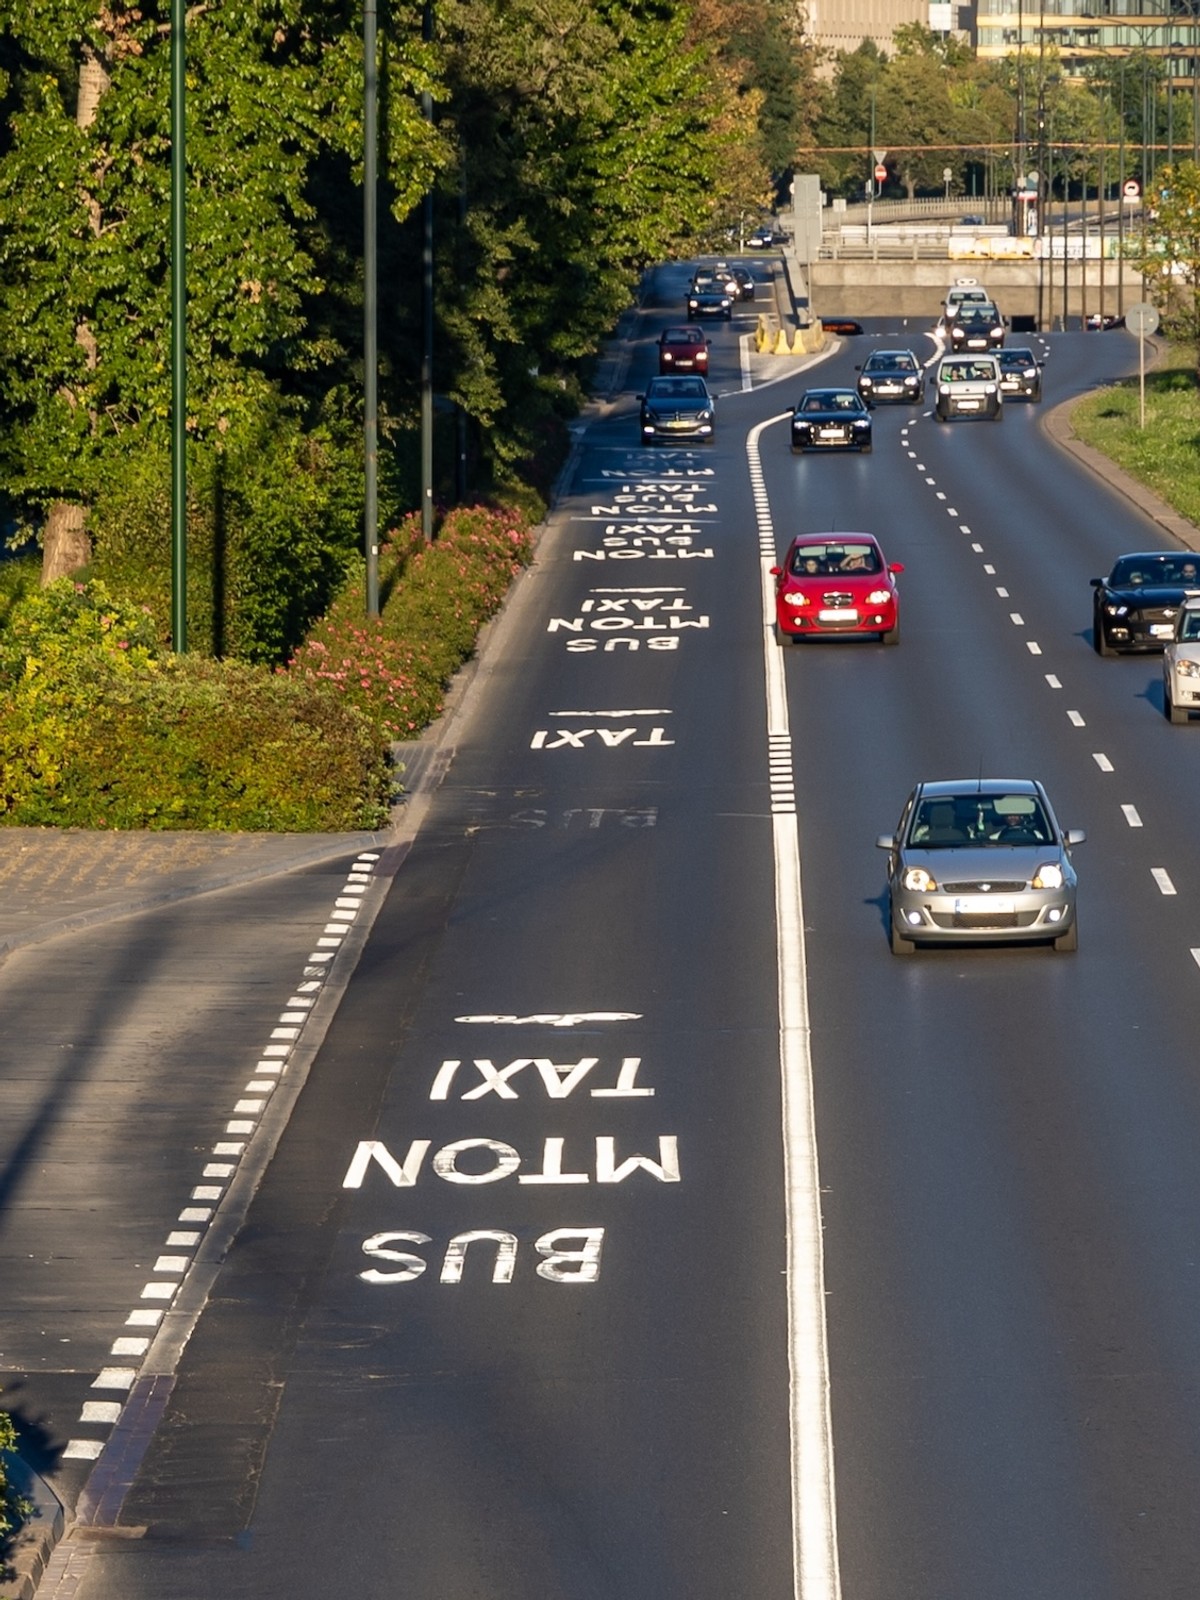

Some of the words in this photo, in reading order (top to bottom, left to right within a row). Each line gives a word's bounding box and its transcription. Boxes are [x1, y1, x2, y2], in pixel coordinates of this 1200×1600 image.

[600, 468, 716, 478] MTON
[622, 484, 707, 493] TAXI
[614, 493, 695, 503] BUS
[590, 504, 719, 515] MTON
[605, 524, 701, 535] TAXI
[602, 536, 693, 547] BUS
[573, 548, 715, 561] MTON
[581, 598, 693, 613] TAXI
[547, 615, 710, 633] MTON
[566, 636, 679, 652] BUS
[530, 727, 676, 750] TAXI
[429, 1057, 655, 1101] TAXI
[342, 1135, 681, 1189] MTON
[356, 1227, 605, 1284] BUS
